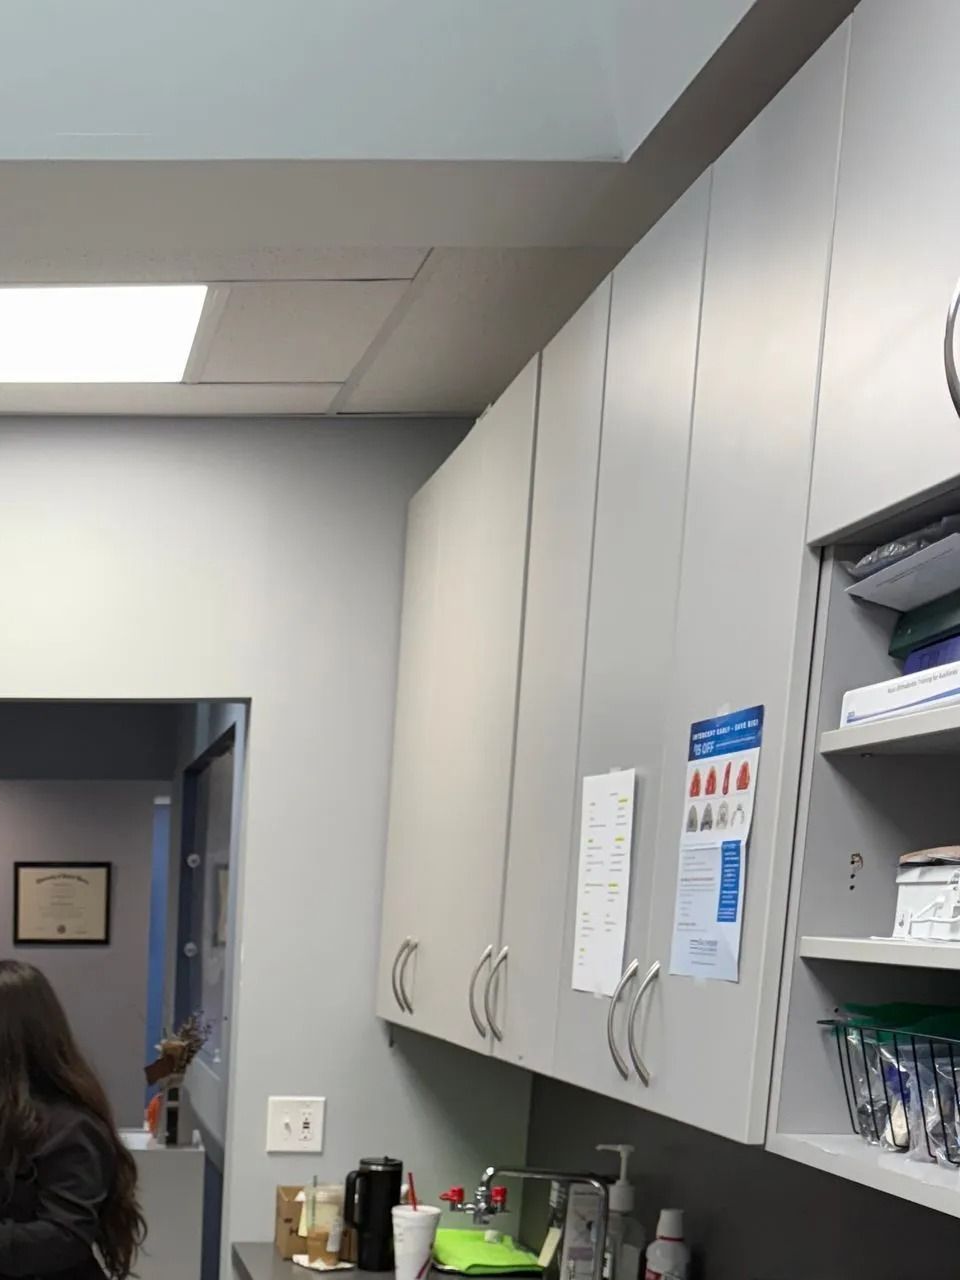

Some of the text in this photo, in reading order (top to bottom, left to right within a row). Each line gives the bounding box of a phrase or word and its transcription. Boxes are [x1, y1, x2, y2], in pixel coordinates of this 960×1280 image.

[716, 726, 730, 735] EARLY
[735, 721, 746, 731] SAVE
[701, 741, 715, 754] OFF
